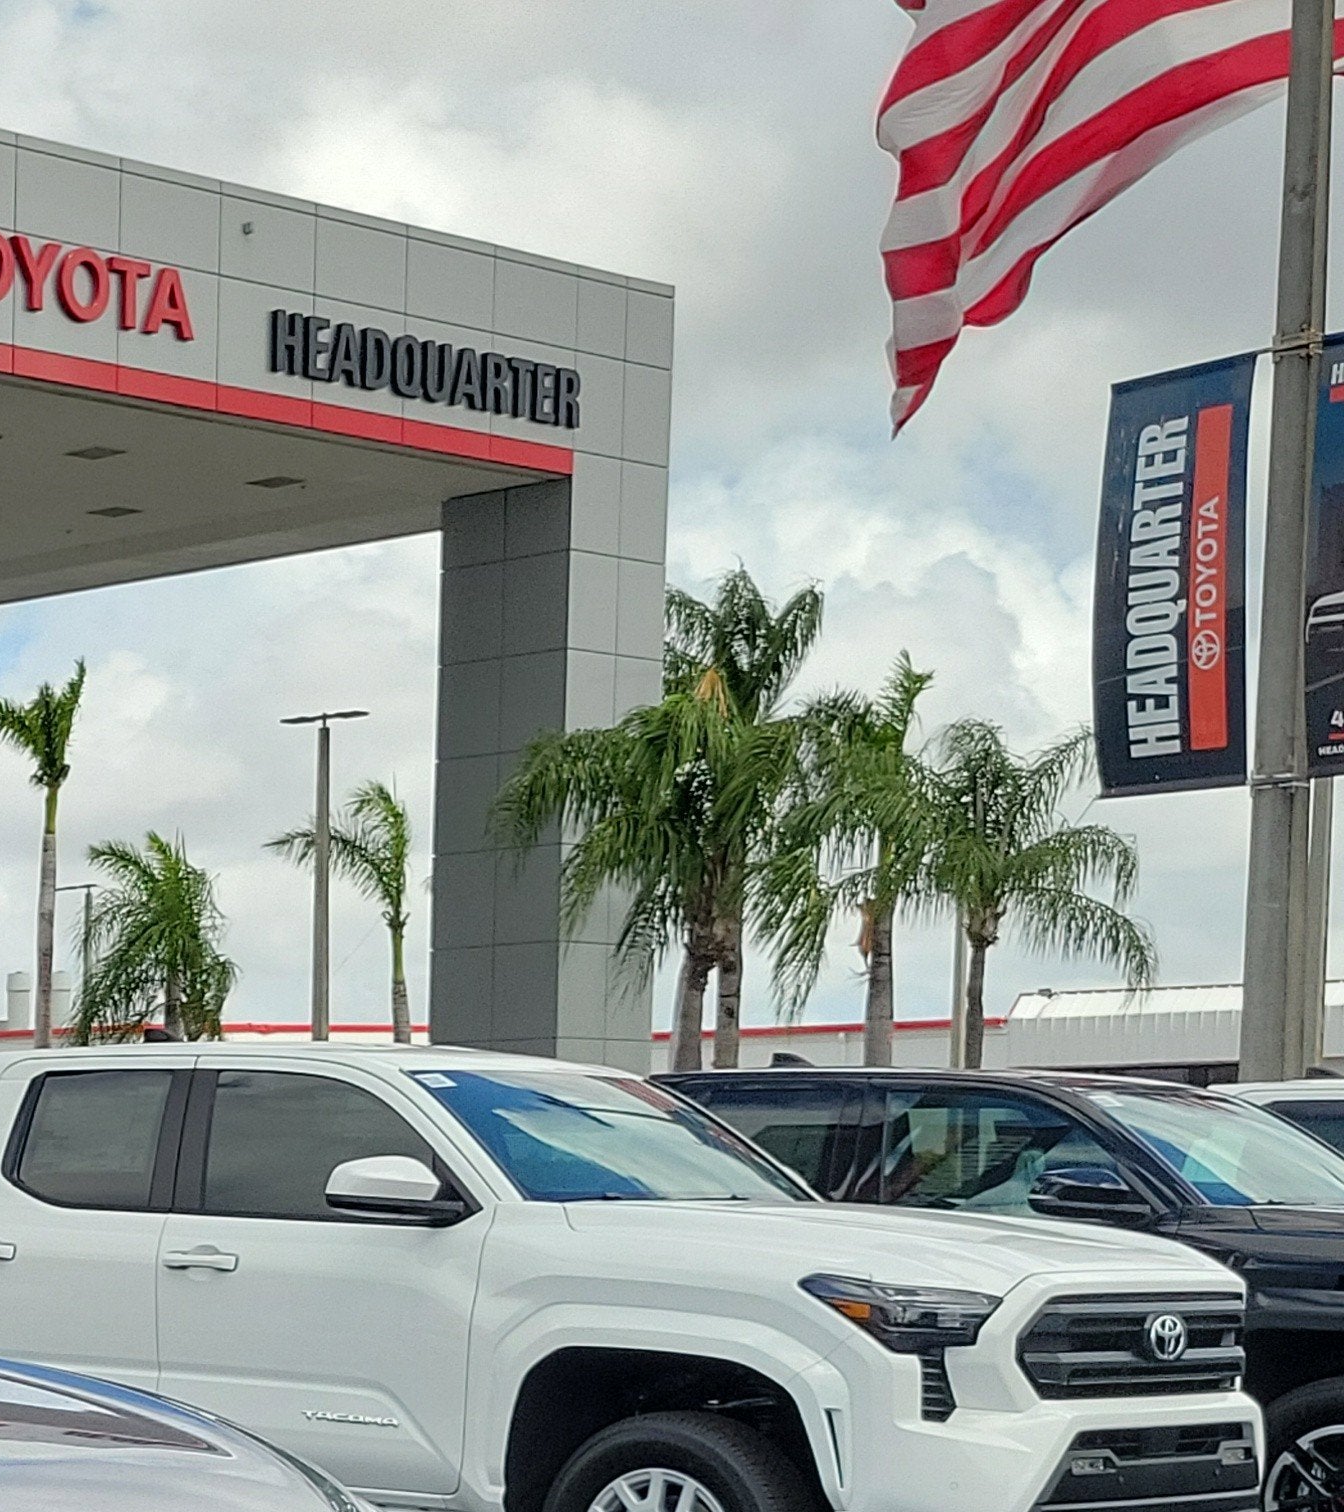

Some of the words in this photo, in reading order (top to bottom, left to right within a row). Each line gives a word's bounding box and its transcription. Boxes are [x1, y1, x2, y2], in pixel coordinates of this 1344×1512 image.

[269, 308, 581, 428] HEADQUARTER
[1126, 414, 1189, 759] HEADQUARTER
[1194, 496, 1220, 628] TOYOTA
[301, 1409, 400, 1428] TACOMA
